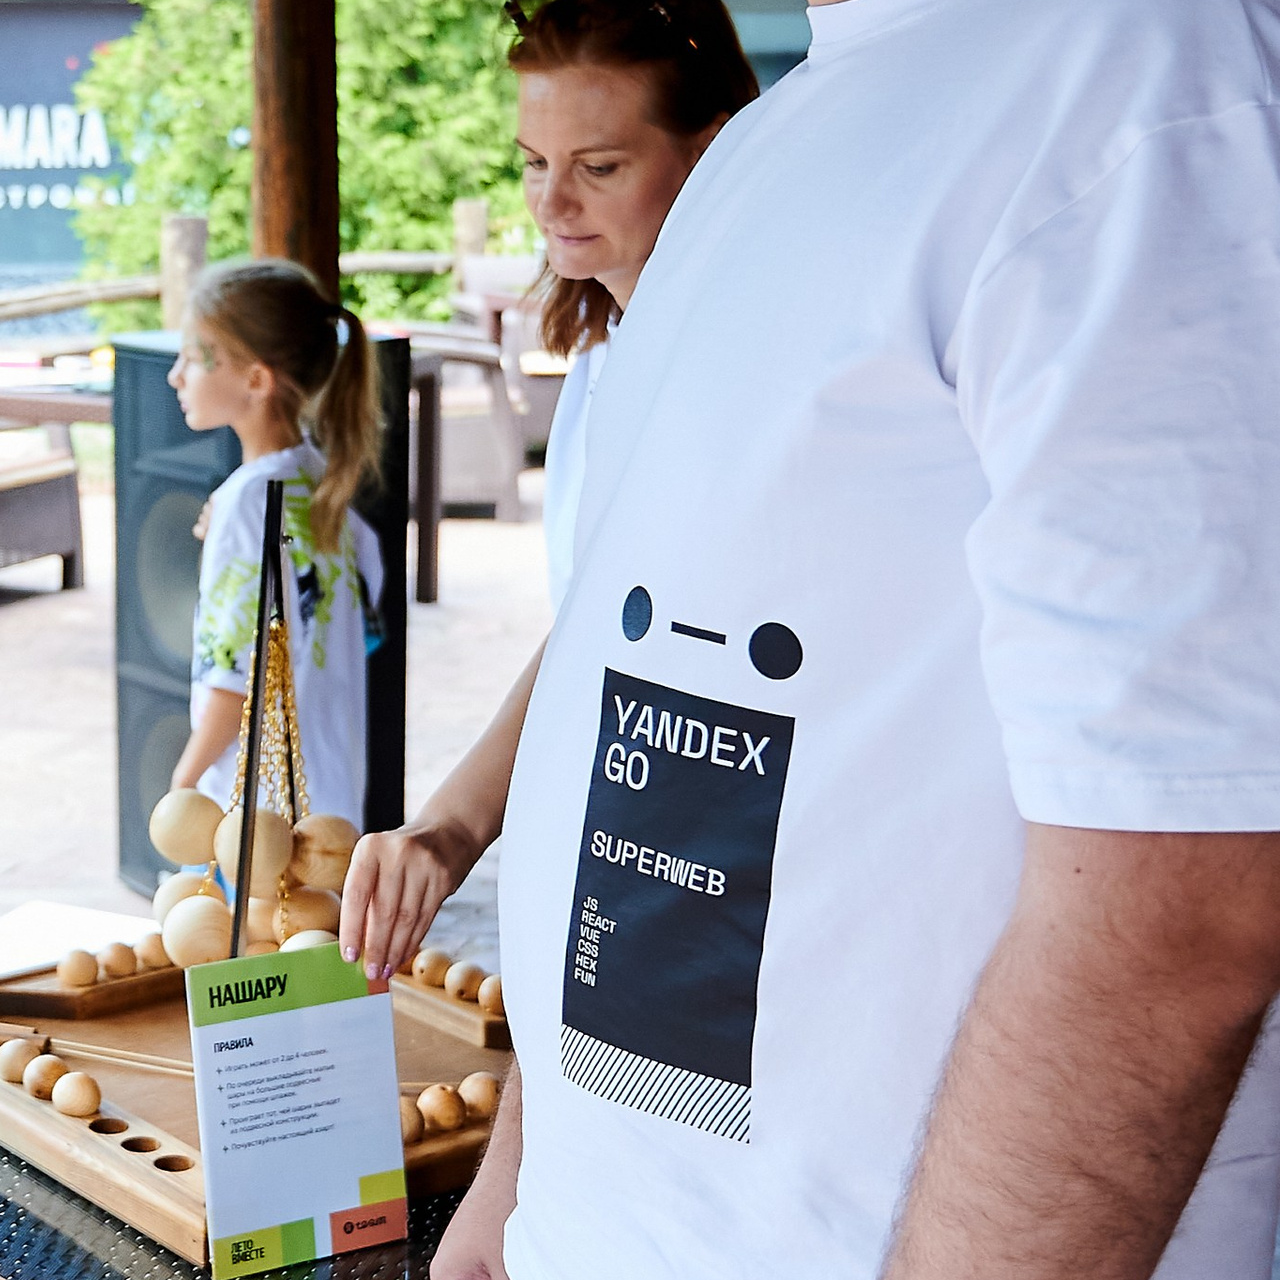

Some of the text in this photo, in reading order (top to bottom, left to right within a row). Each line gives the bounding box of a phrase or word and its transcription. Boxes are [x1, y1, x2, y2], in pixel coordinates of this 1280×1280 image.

[613, 694, 771, 775] YANDEX
[604, 742, 650, 791] GO
[590, 830, 726, 897] SUPERWEB
[583, 896, 598, 911] JS
[581, 911, 617, 934] REACT
[579, 925, 601, 944] VUE
[577, 939, 599, 958] CSS
[575, 953, 597, 972] HEX
[574, 967, 596, 987] FUN
[208, 973, 288, 1009] НАШАРУ
[213, 1037, 254, 1053] ПРАВИЛА
[231, 1239, 254, 1254] ЛЕТО
[231, 1246, 265, 1265] ВМЕСТЕ
